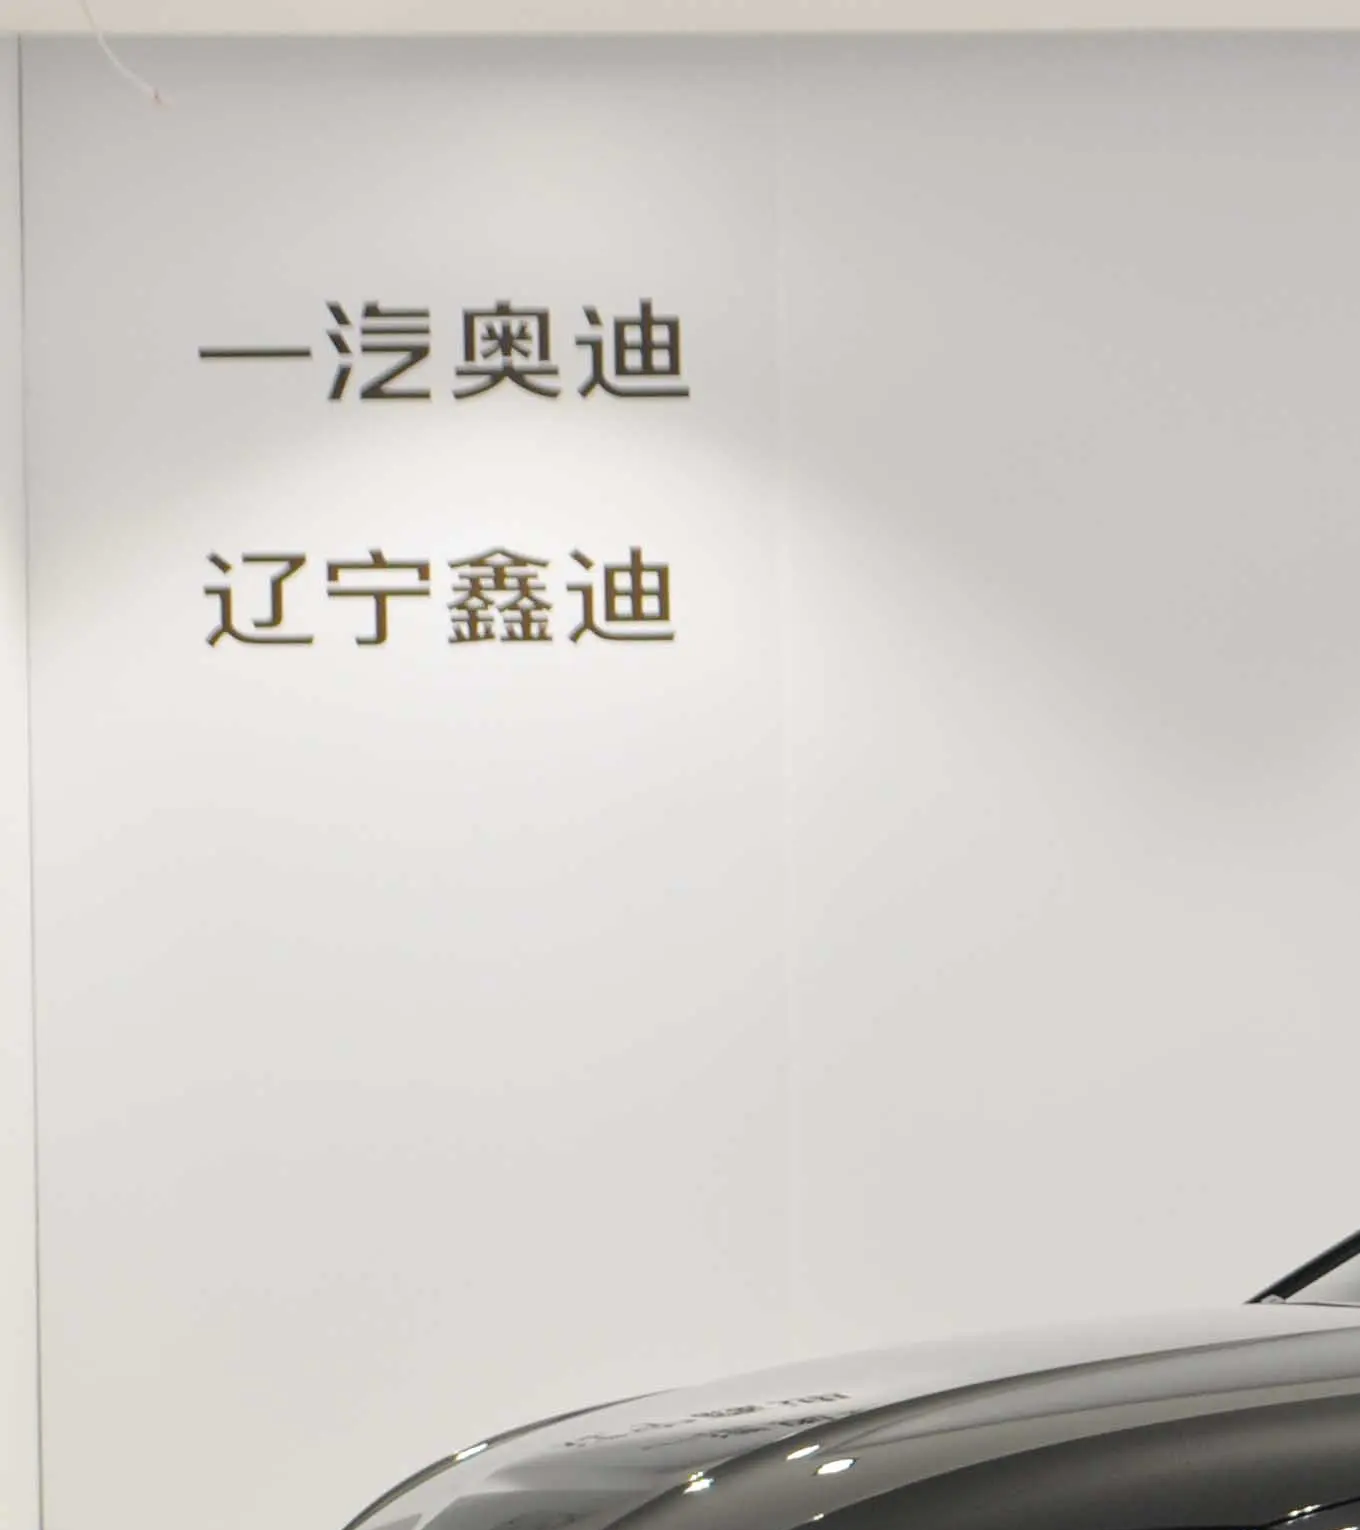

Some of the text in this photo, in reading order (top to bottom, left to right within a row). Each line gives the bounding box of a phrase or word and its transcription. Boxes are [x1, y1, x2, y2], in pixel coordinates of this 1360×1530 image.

[198, 298, 690, 401] 一汽奥迪
[203, 546, 675, 647] 辽宁鑫迪
